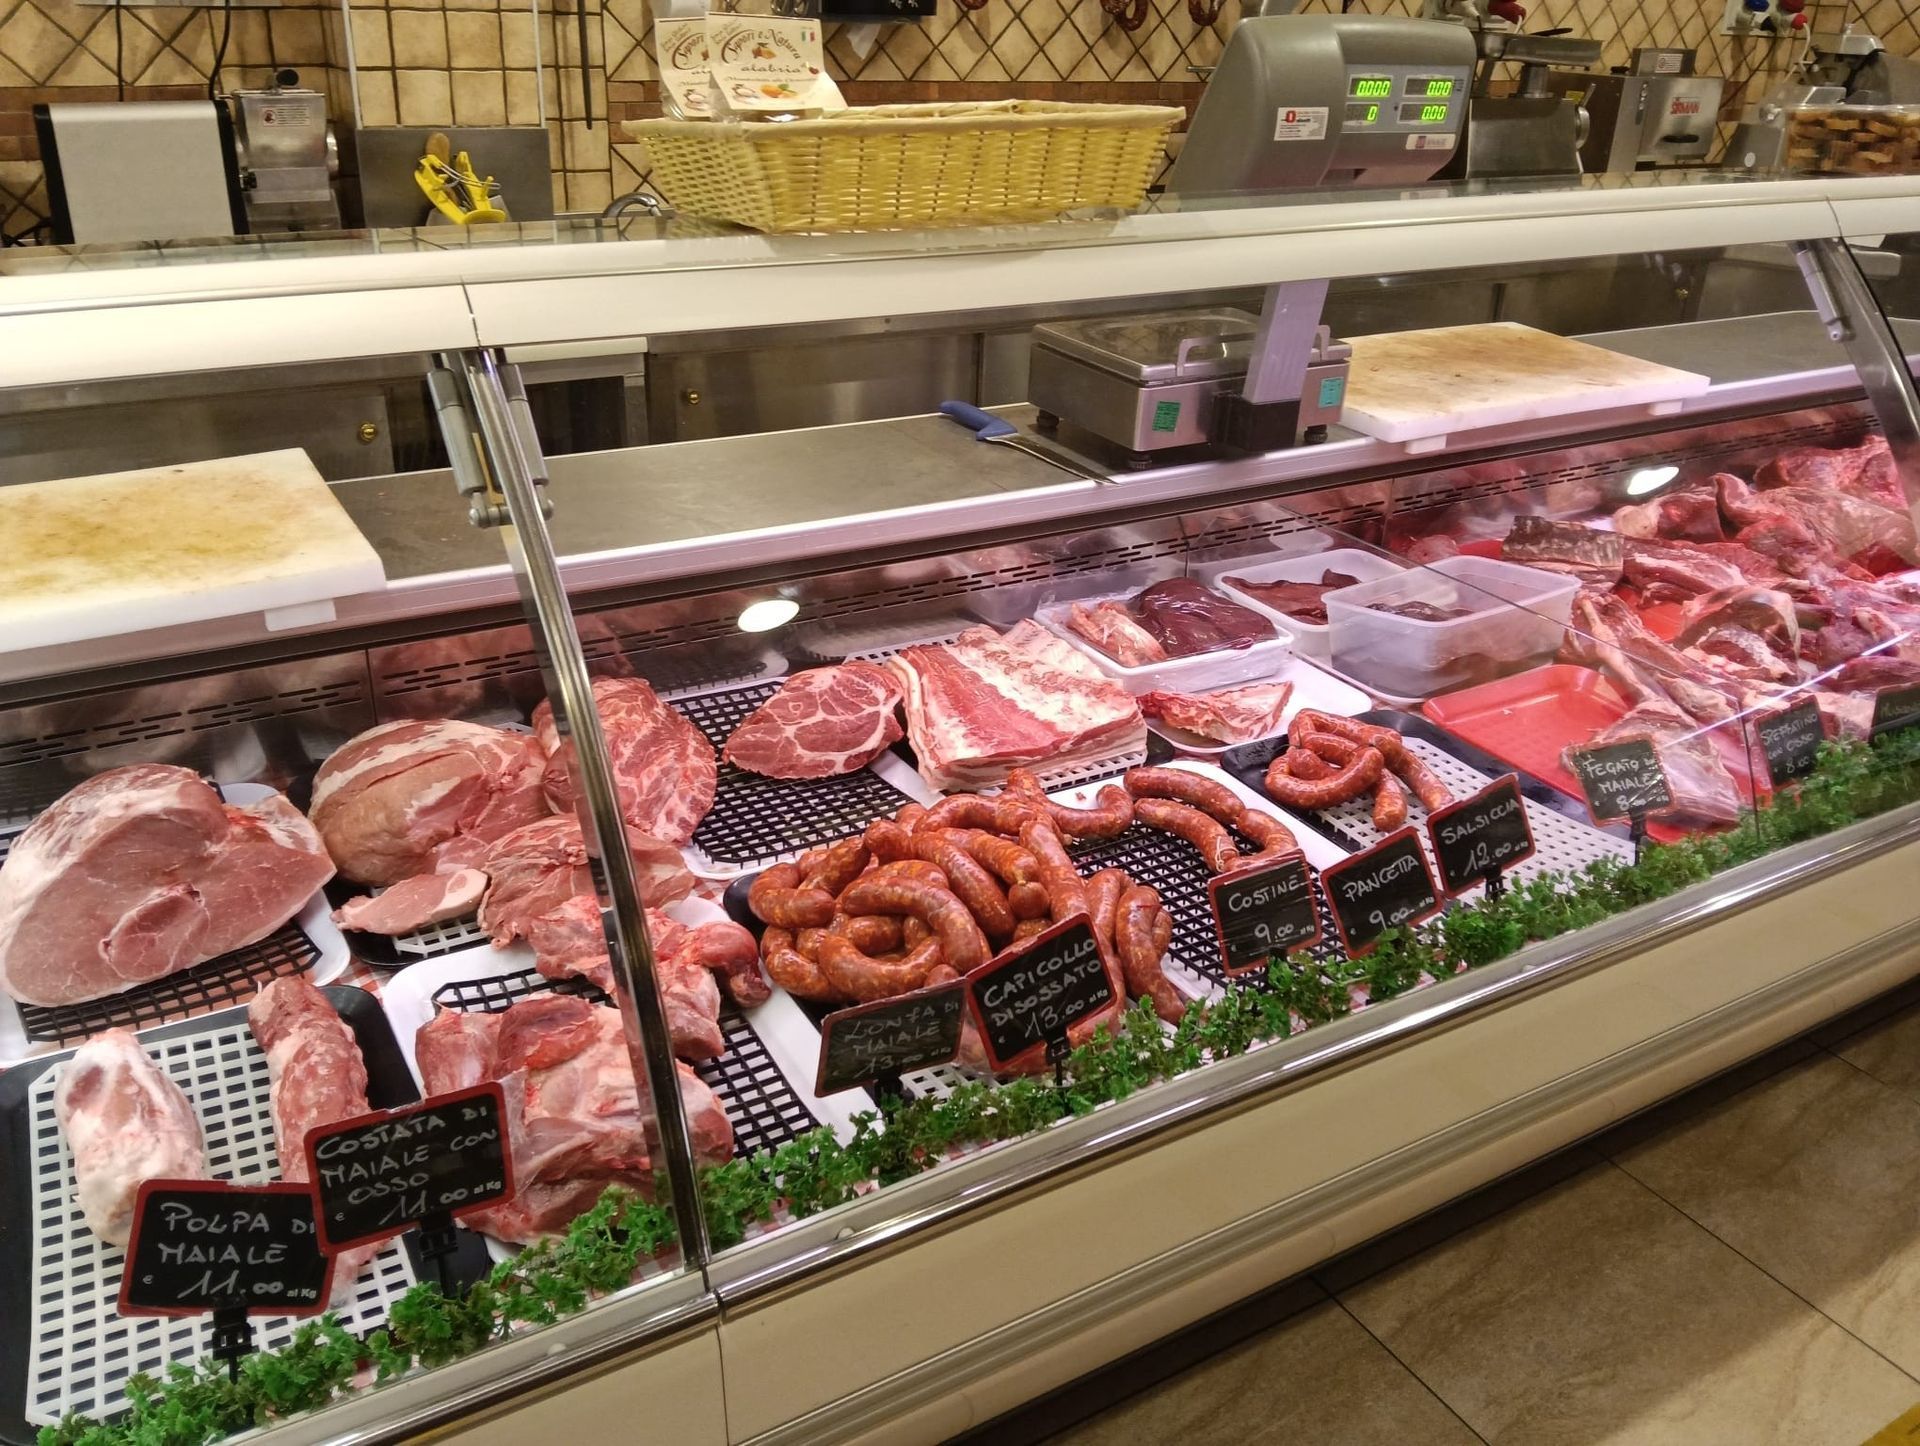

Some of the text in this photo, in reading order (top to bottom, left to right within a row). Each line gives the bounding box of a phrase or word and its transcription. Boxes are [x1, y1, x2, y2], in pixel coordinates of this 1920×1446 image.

[1426, 81, 1452, 96] 0.00
[1367, 105, 1378, 120] 0
[1421, 105, 1447, 120] 0.00
[1582, 755, 1639, 779] FEGATO
[1598, 772, 1653, 794] MAIALE
[1441, 798, 1520, 844] SALSICCIA
[1463, 842, 1511, 877] 12.00
[1228, 875, 1300, 912] COSTINE
[1342, 855, 1419, 902] PANCETTA
[1254, 923, 1294, 943] 9.00
[983, 938, 1097, 1007] CAPICOLLO
[991, 959, 1100, 1027] DISOSSATO
[1025, 1000, 1085, 1038] 13.00
[853, 1021, 941, 1056] MAIALE
[316, 1106, 488, 1159] COSTATA DI
[320, 1129, 498, 1188] MAIALE CON
[348, 1173, 430, 1205] OSSO
[160, 1202, 315, 1234] POLPA DI
[379, 1189, 469, 1225] 11.00
[158, 1242, 288, 1265] MAIALE
[177, 1270, 284, 1299] 11.00
[287, 1288, 298, 1298] al
[300, 1288, 317, 1299] Kg
